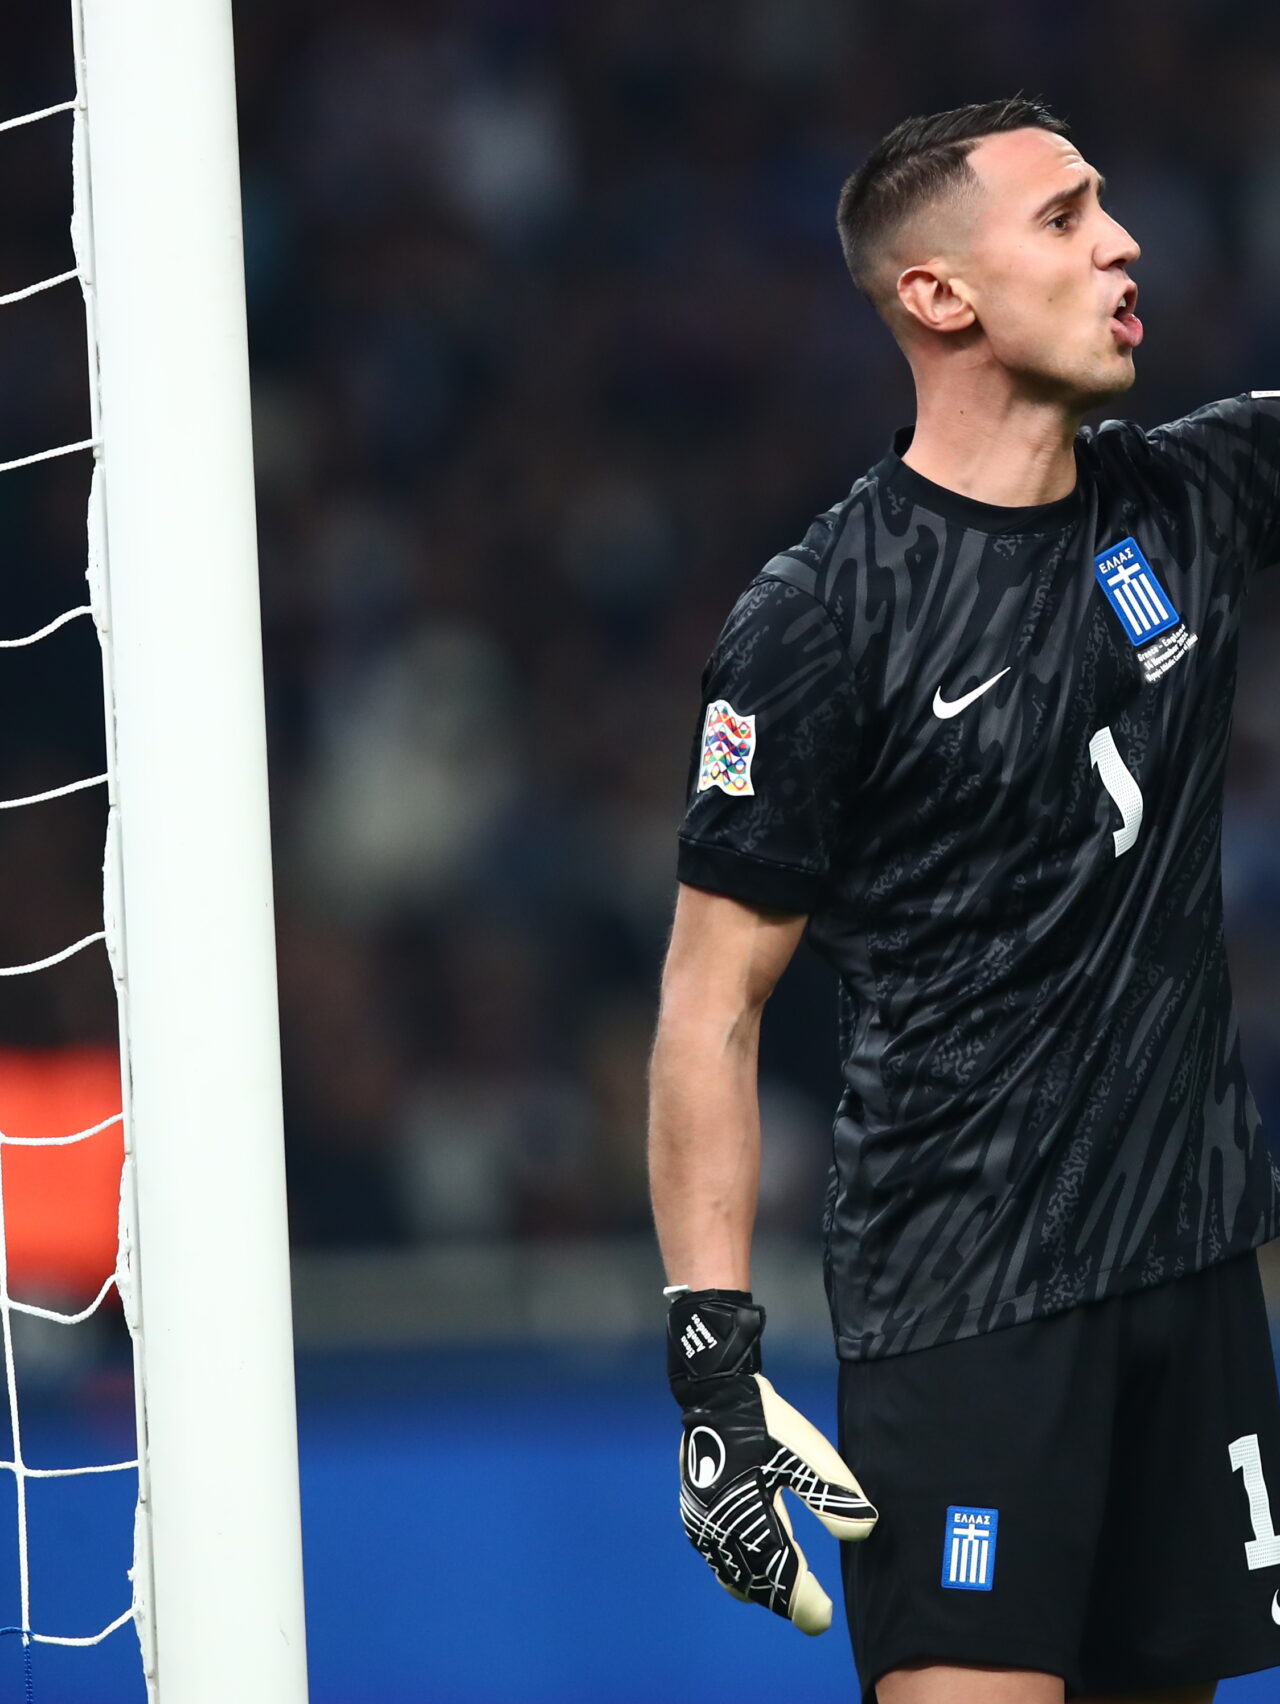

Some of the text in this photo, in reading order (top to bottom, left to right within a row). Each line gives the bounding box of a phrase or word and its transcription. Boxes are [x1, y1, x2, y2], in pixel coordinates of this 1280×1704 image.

[1098, 547, 1135, 575] ΕΛΛΑΣ
[1088, 725, 1144, 859] 1
[953, 1512, 991, 1526] ΕΛΛΑΣ
